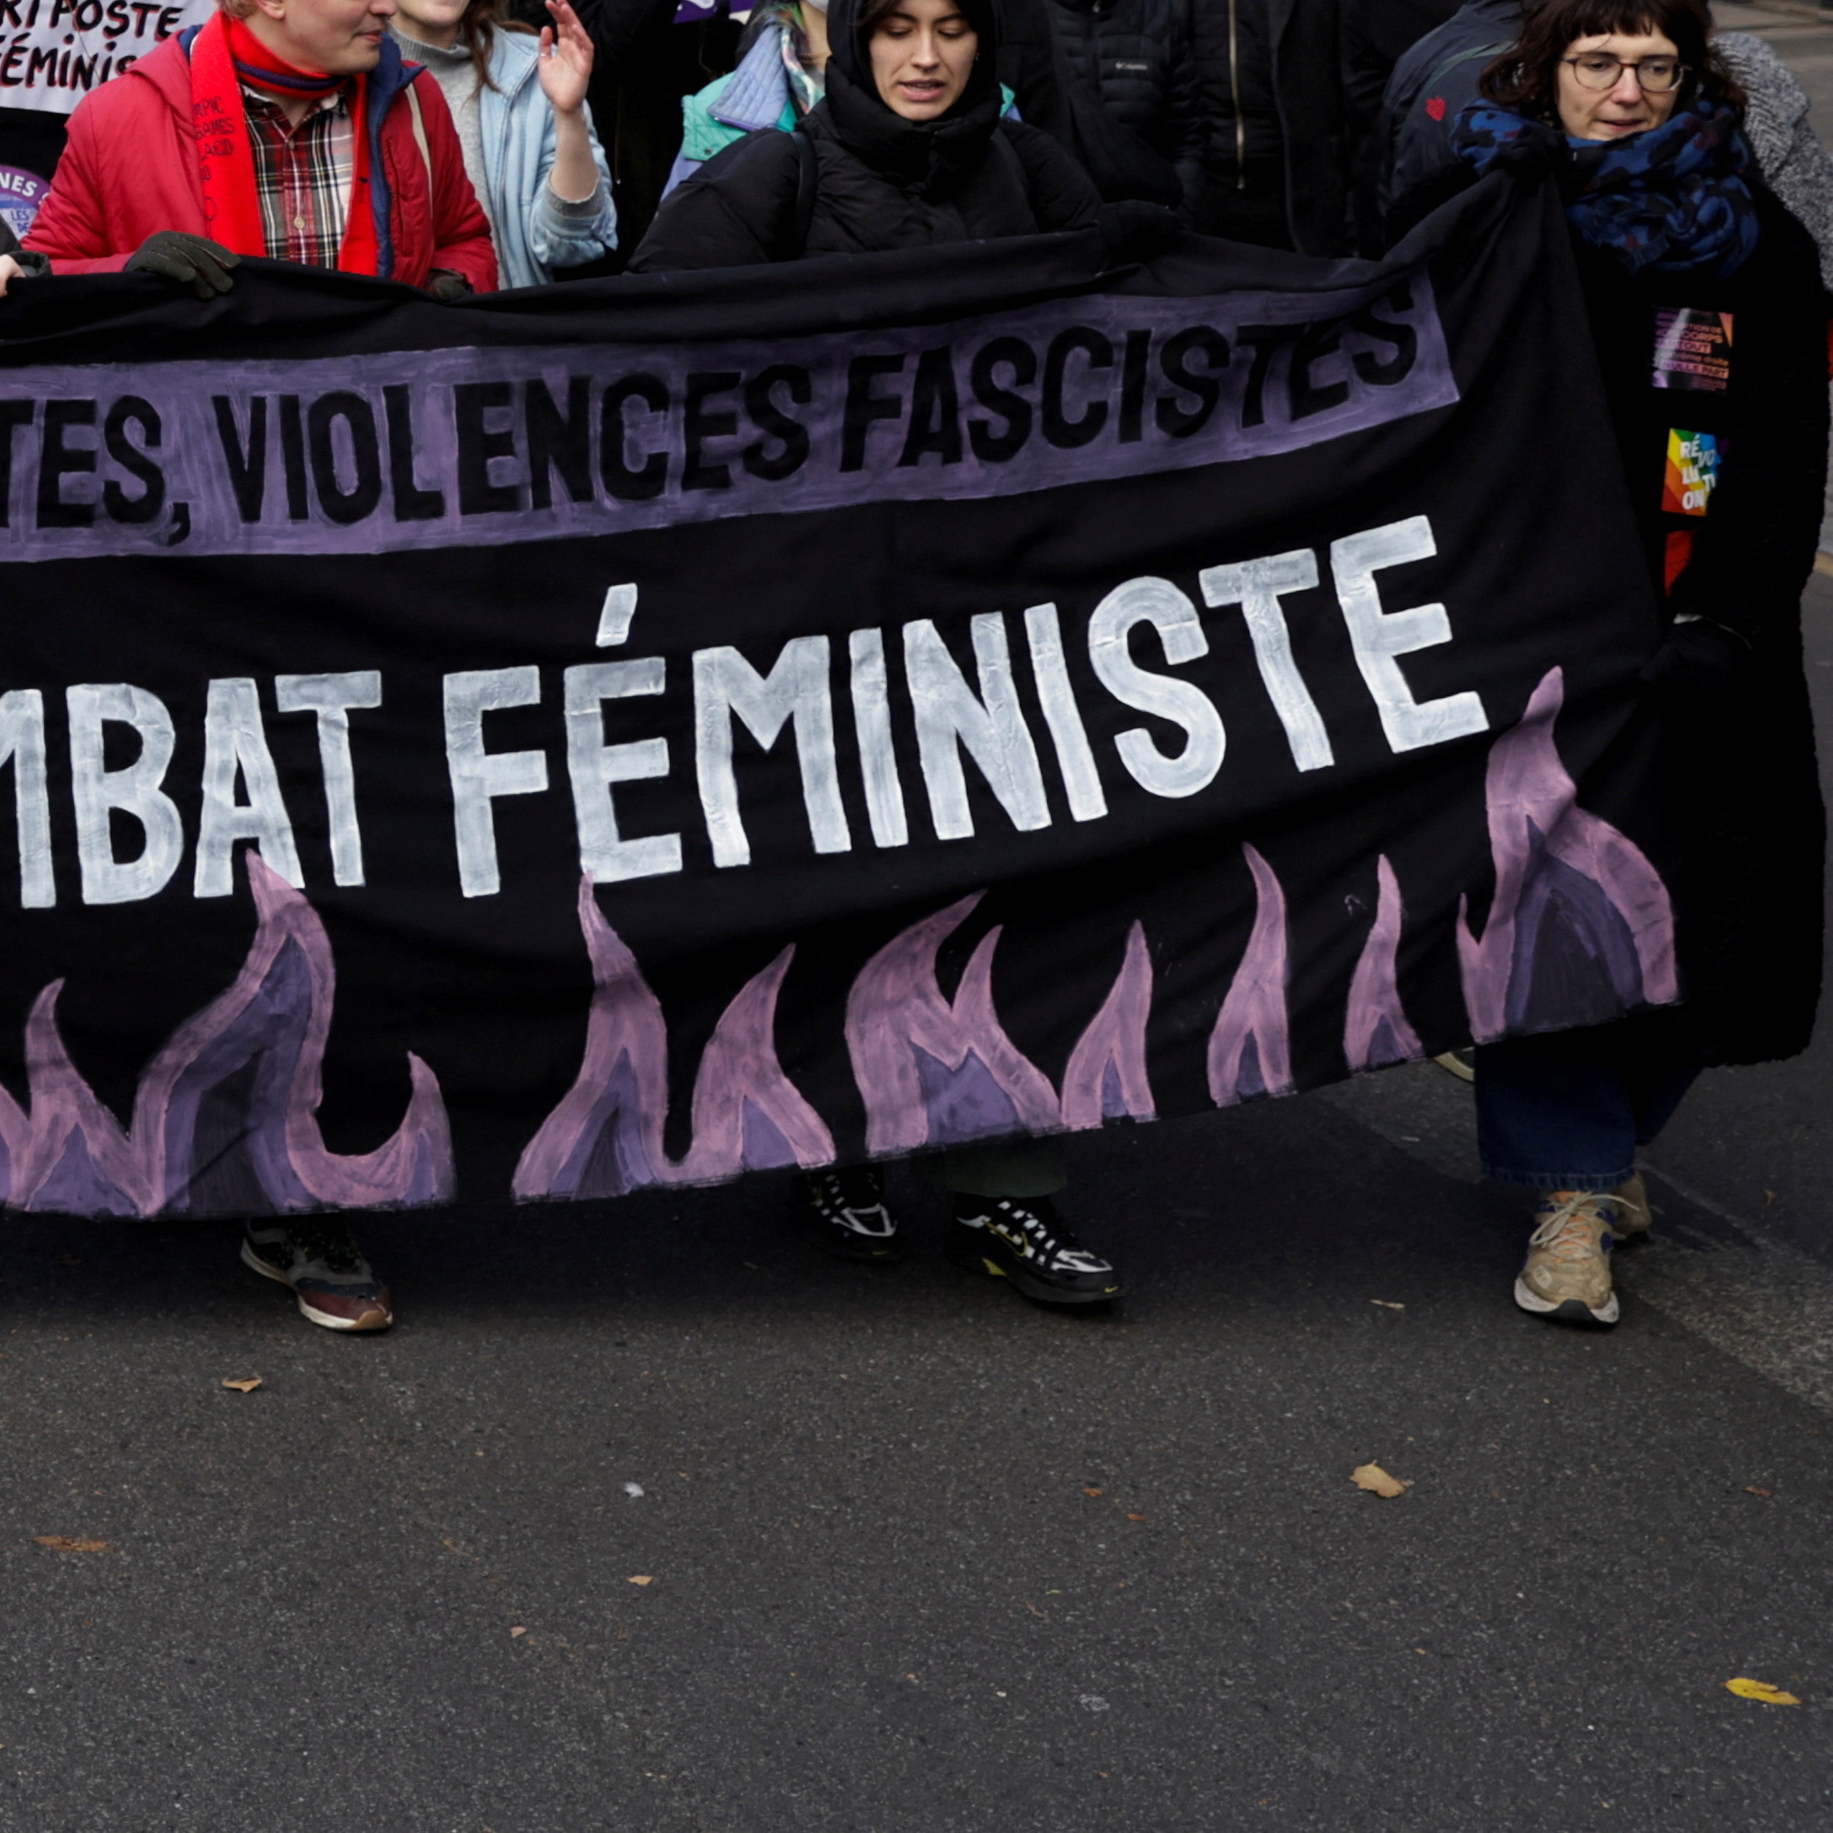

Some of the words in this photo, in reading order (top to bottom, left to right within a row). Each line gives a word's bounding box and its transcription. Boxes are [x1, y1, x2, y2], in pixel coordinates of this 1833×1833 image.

[11, 211, 29, 221] LES
[211, 363, 812, 522] VIOLENCES
[838, 280, 1419, 474] FASCISTES
[442, 513, 1490, 898] FÉMINISTE
